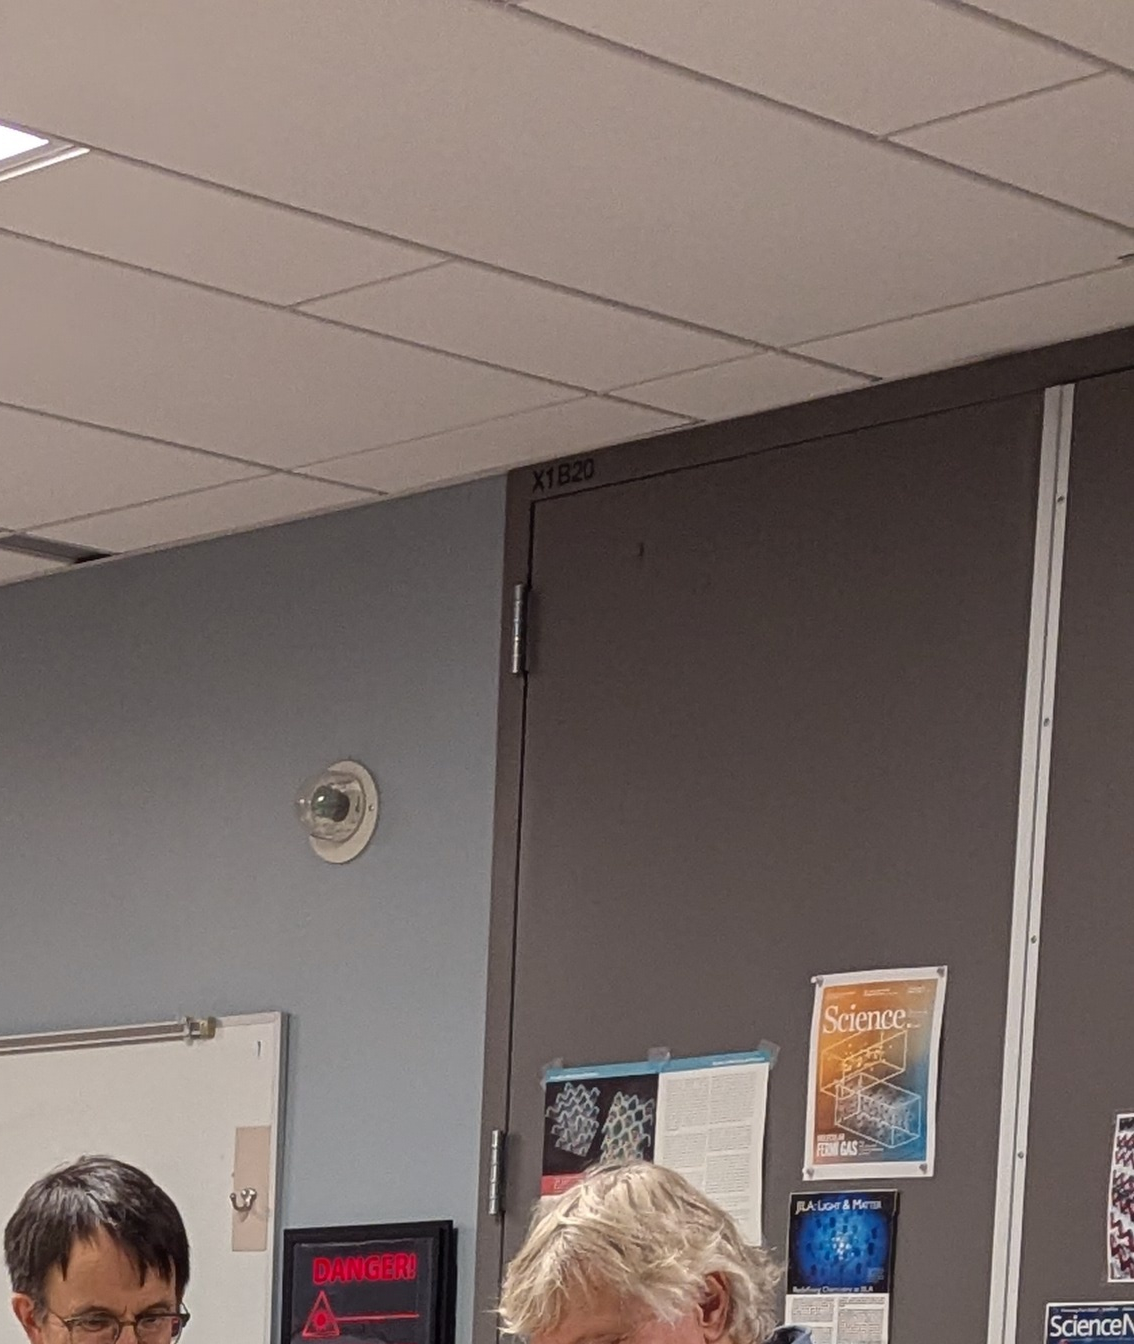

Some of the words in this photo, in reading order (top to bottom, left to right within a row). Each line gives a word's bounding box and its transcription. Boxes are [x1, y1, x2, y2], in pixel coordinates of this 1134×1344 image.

[532, 459, 594, 494] X1B20
[823, 1004, 906, 1034] Science
[840, 1140, 858, 1156] GAS
[842, 1199, 850, 1210] &
[313, 1253, 418, 1285] DANGER!
